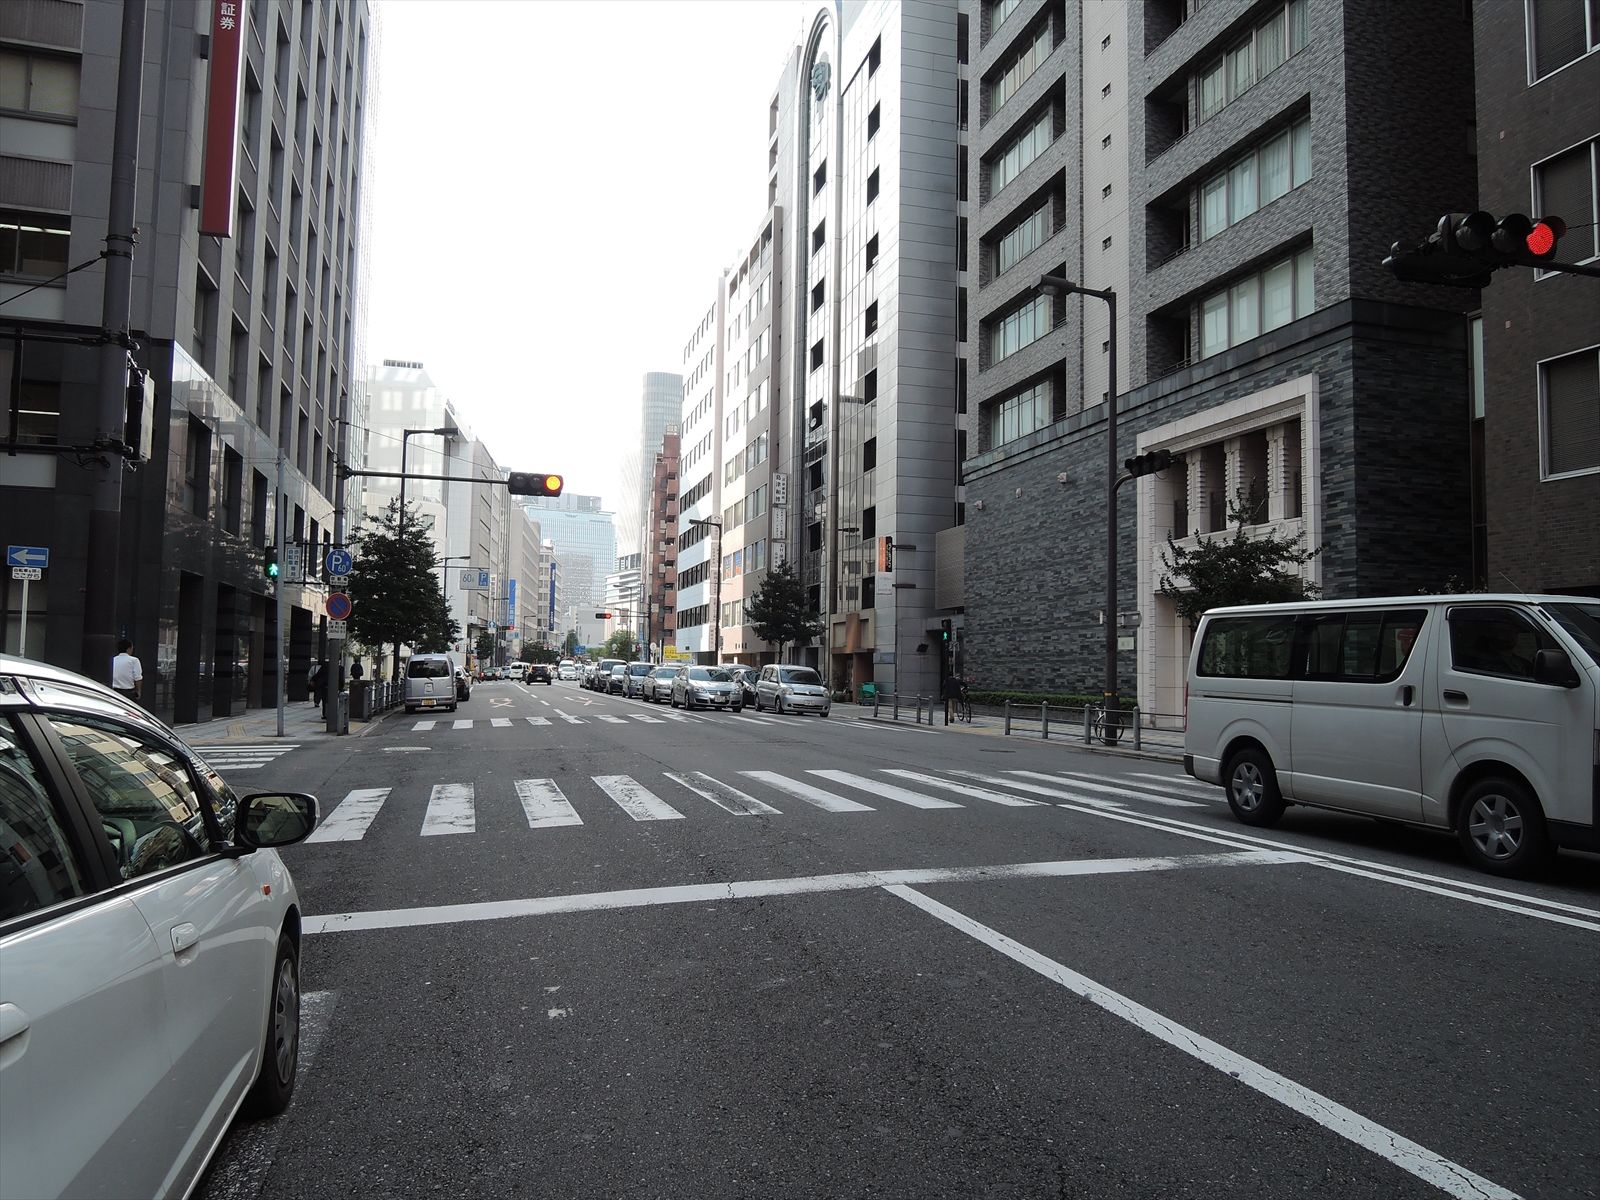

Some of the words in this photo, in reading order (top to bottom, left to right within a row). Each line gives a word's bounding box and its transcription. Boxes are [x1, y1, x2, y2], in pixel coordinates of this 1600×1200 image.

[219, 2, 236, 30] 証券
[331, 555, 342, 571] P
[338, 564, 346, 573] 60
[463, 574, 472, 583] 60
[481, 573, 487, 581] P
